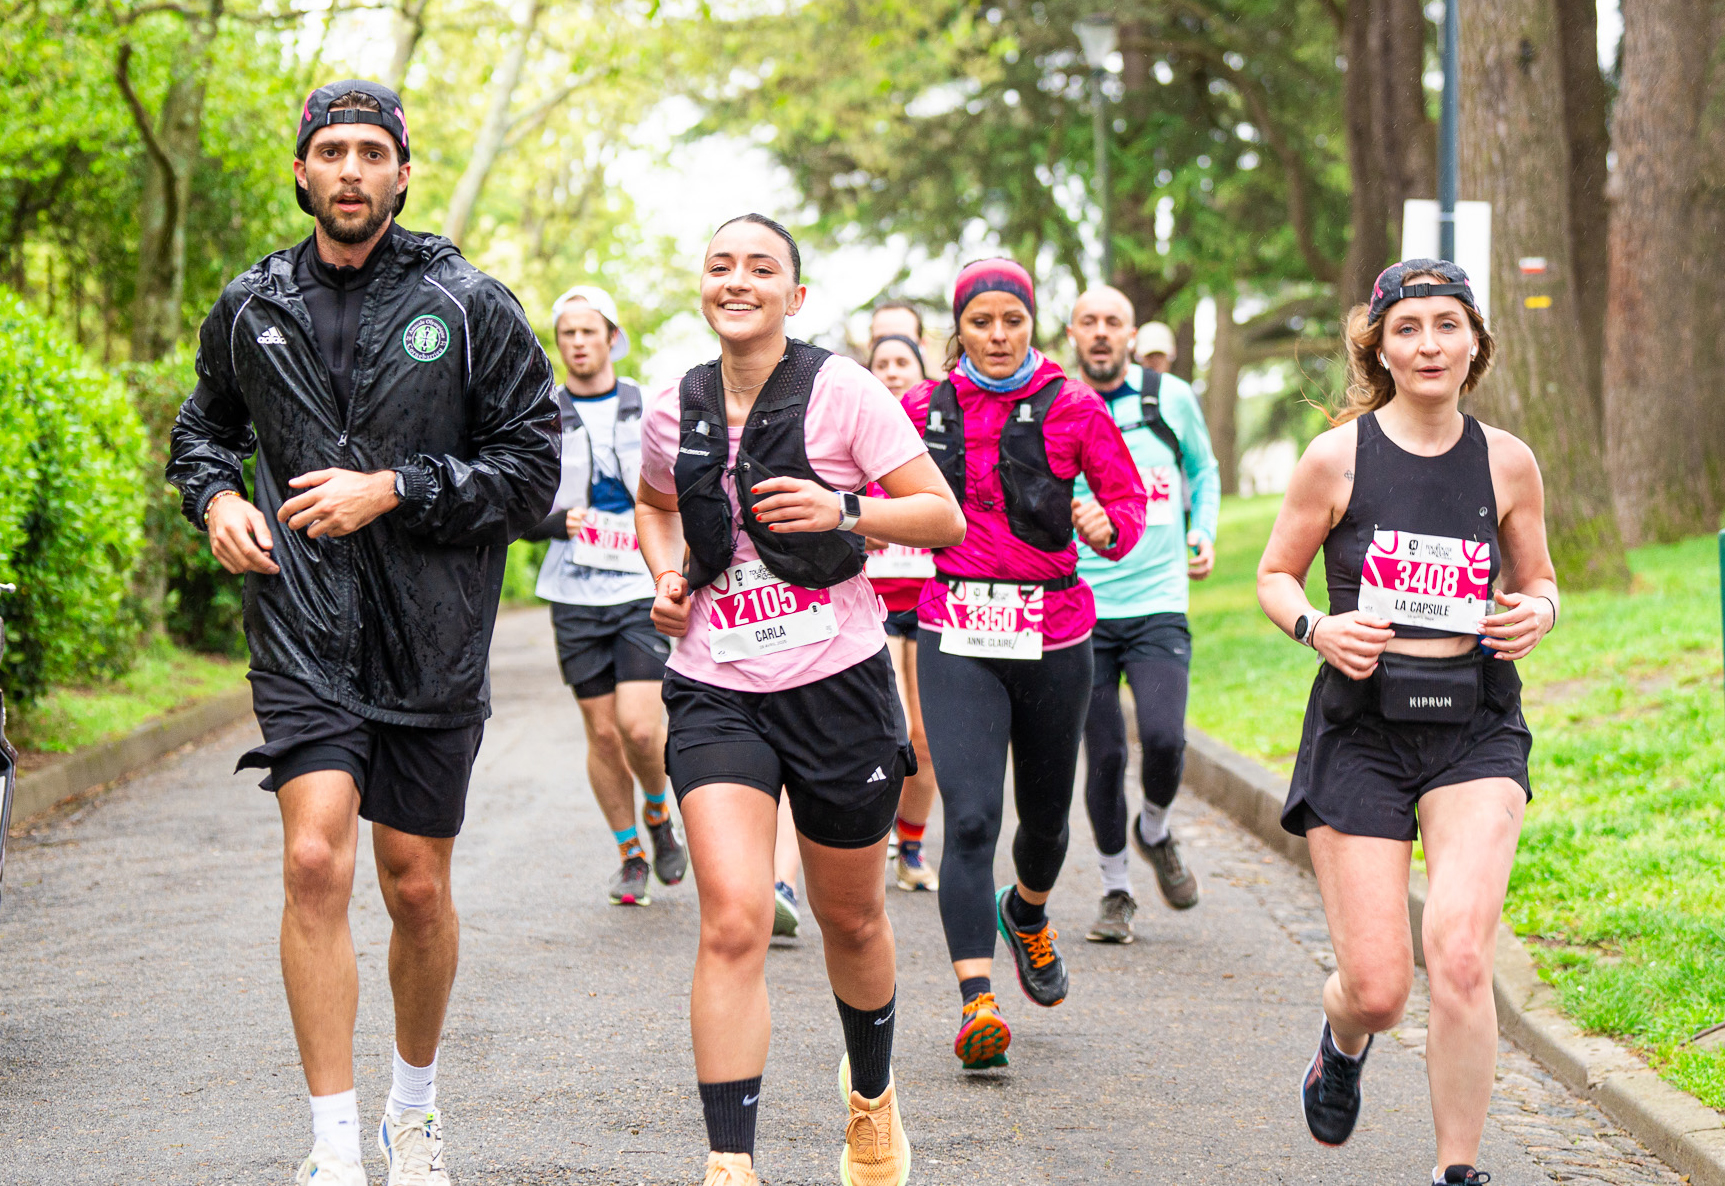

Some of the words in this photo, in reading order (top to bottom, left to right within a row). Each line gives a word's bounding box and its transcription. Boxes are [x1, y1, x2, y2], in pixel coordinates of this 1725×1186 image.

[594, 529, 633, 551] 3013
[1394, 560, 1460, 597] 3408
[733, 582, 798, 626] 2105
[1394, 599, 1406, 611] LA
[1410, 602, 1450, 617] CAPSULE
[965, 605, 1017, 632] 3350
[755, 625, 786, 642] CARLA
[967, 637, 985, 647] ANNE
[988, 638, 1013, 648] CLAIRE
[1409, 696, 1452, 708] KIPRUN
